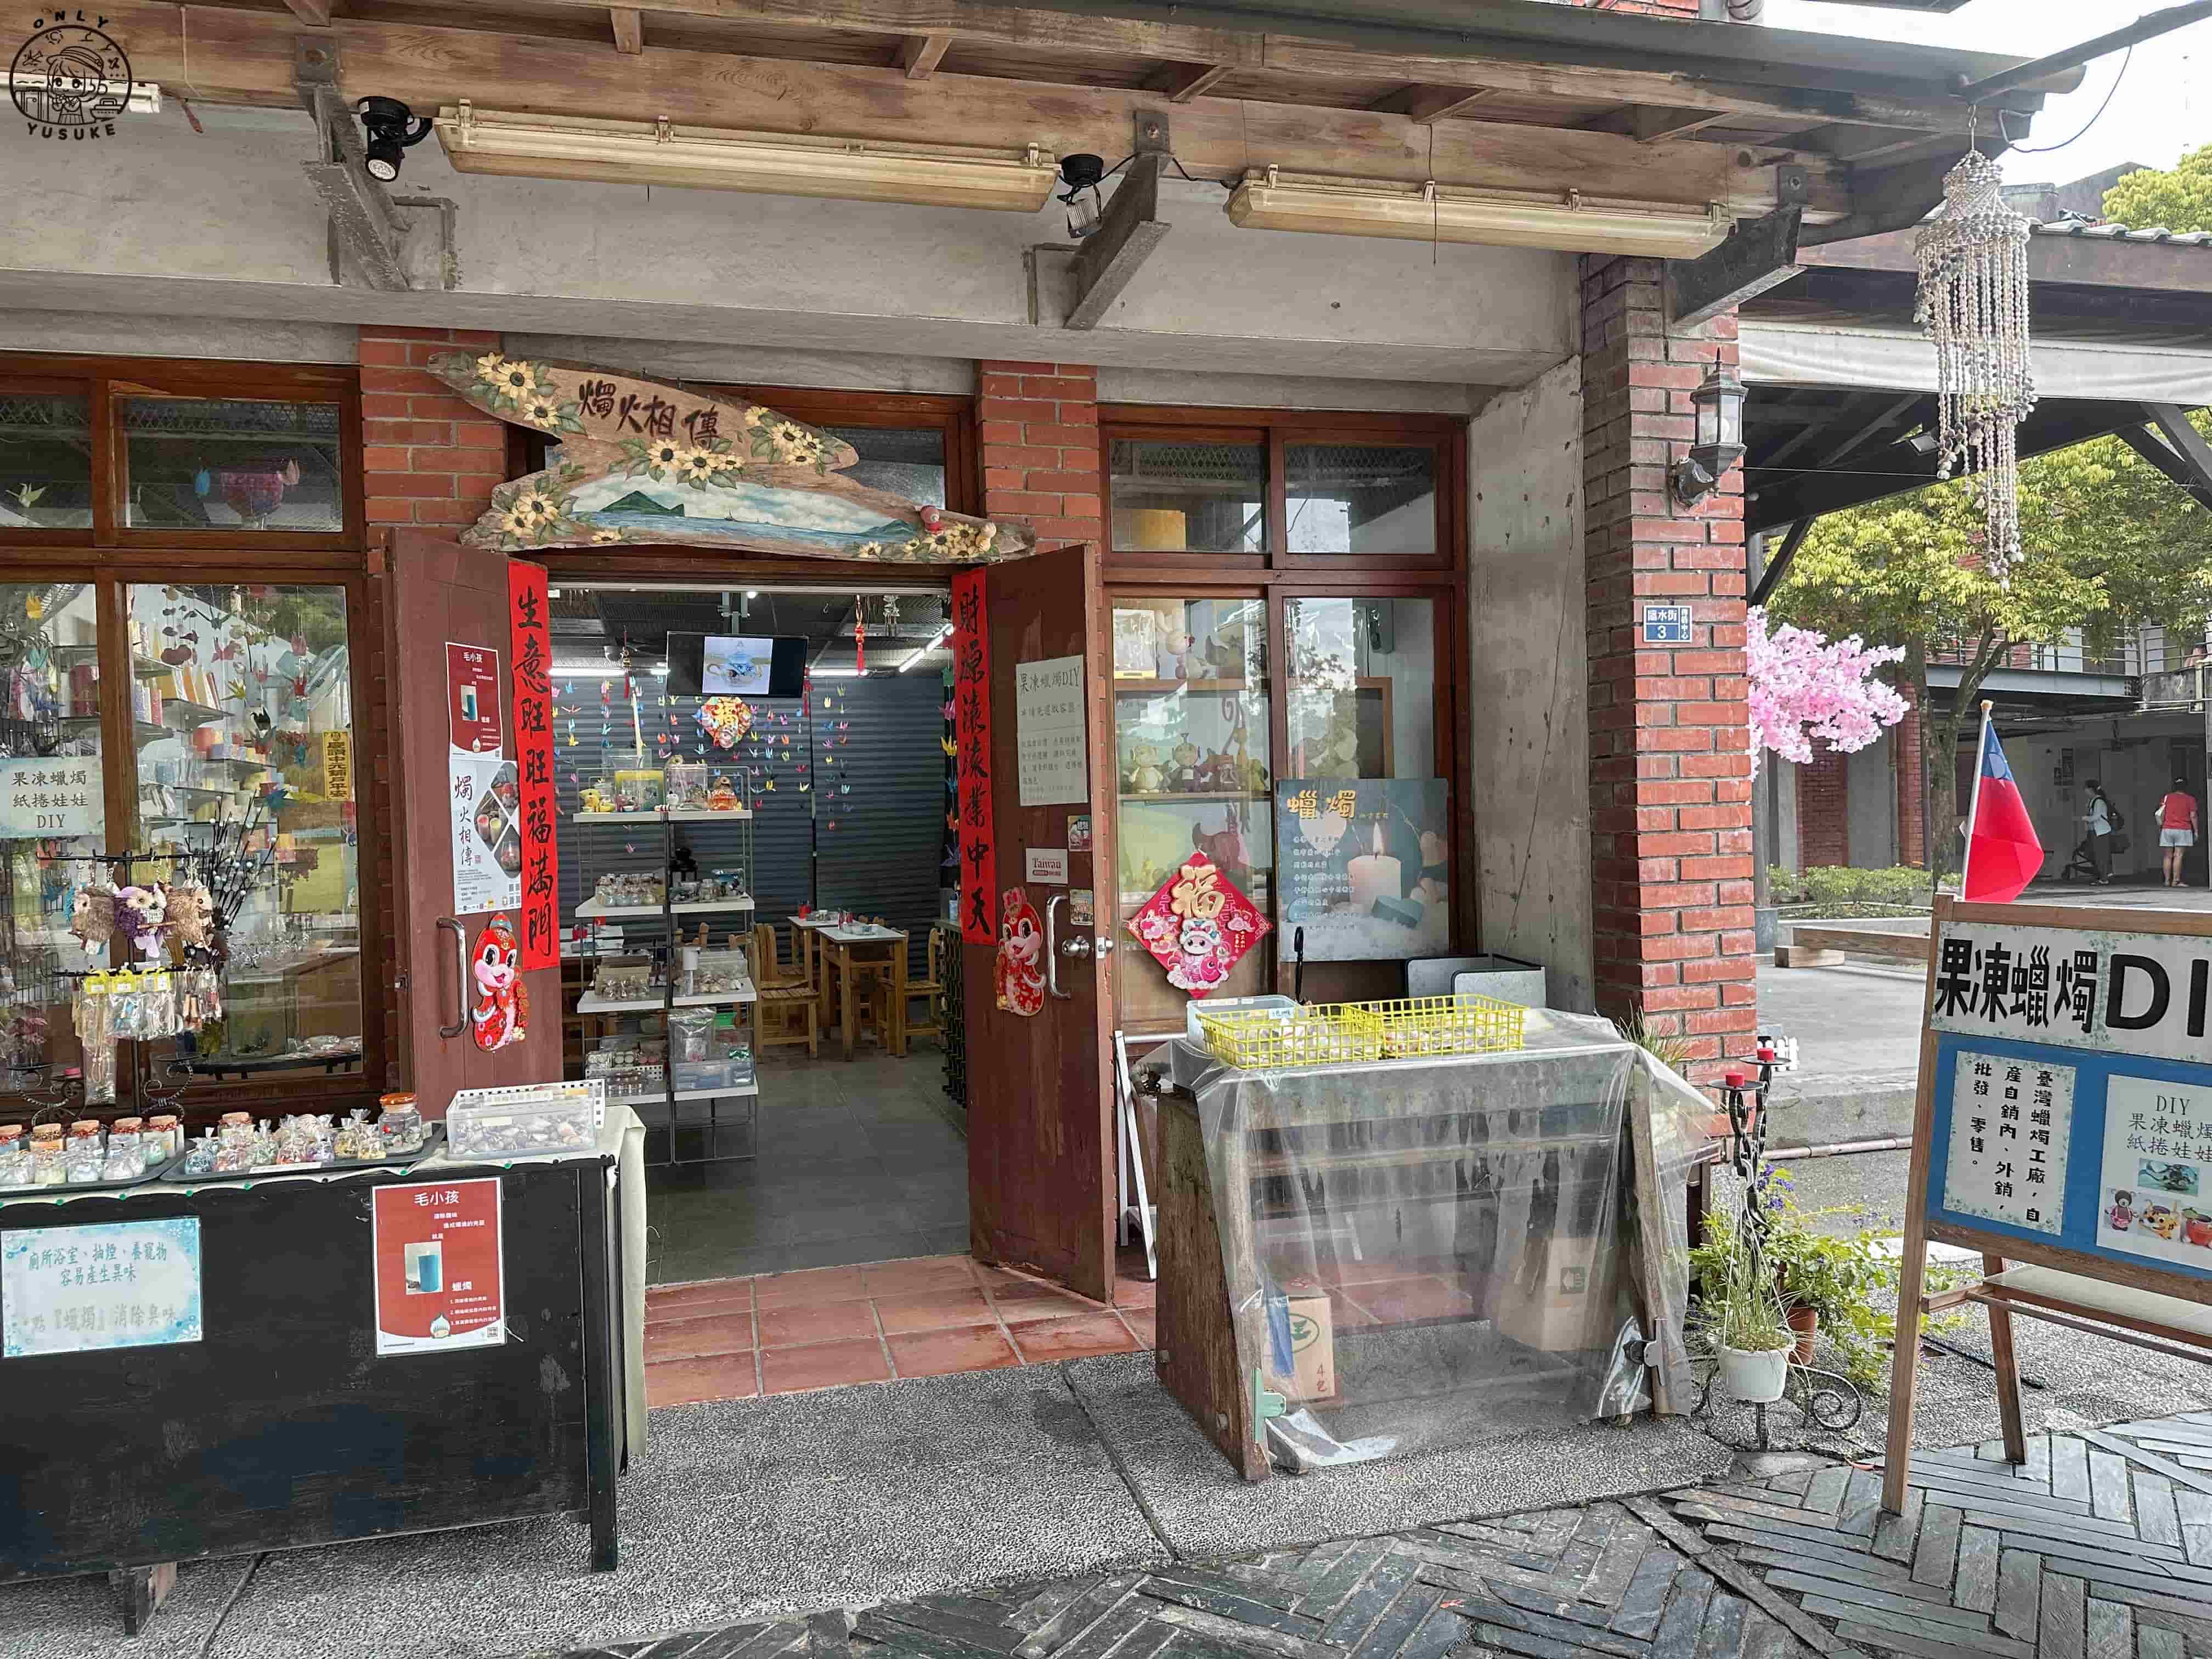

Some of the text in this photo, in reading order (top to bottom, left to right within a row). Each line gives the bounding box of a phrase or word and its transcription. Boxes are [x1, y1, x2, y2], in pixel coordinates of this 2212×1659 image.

[579, 380, 720, 449] 燭火相傳
[1657, 625, 1666, 639] 3
[10, 770, 87, 786] 果凍蠟燭
[514, 585, 553, 957] 生意旺旺福滿門
[1286, 789, 1356, 819] 蠟燭
[36, 814, 66, 828] DIY
[455, 775, 472, 866] 燭火相傳
[1170, 865, 1226, 919] 福
[1934, 938, 2097, 1034] 果凍蠟燭
[2155, 1095, 2190, 1115] DIY
[414, 1190, 460, 1206] 毛小孩
